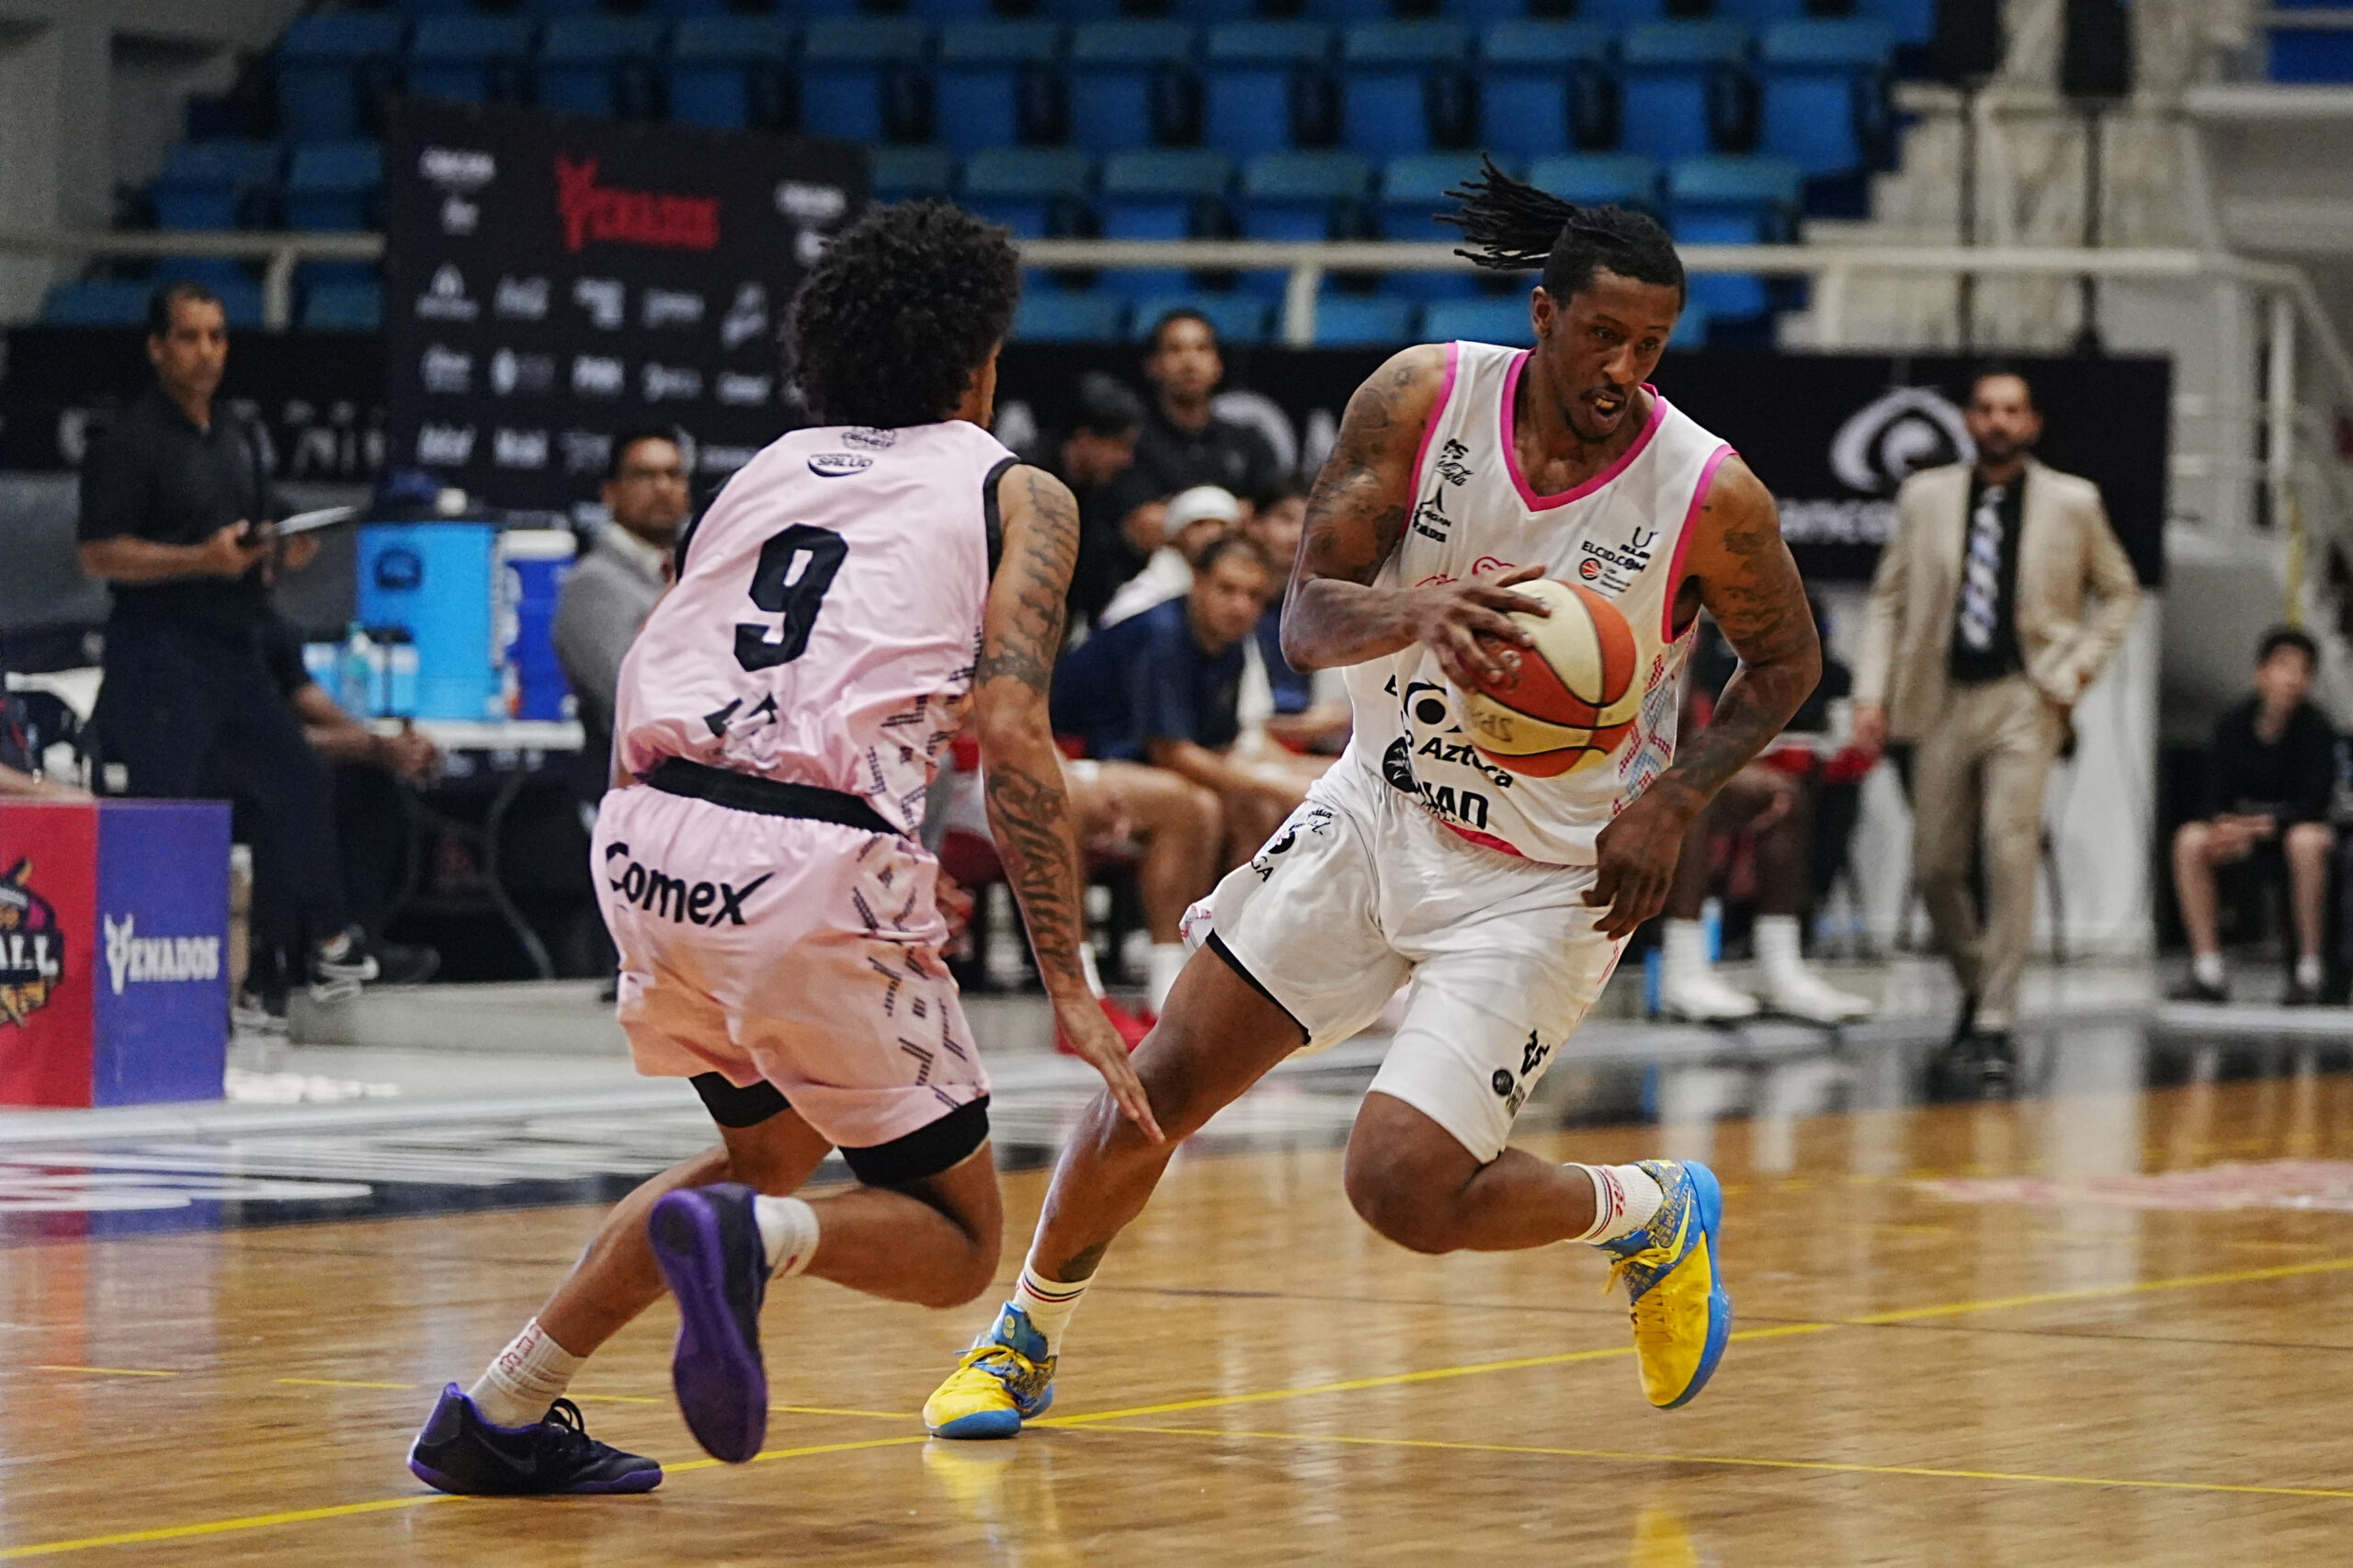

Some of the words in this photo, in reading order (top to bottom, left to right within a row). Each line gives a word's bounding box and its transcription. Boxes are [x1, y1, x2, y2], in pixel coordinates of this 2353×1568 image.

[733, 523, 849, 673] 9
[605, 841, 777, 927] Comex
[103, 913, 221, 995] VENADOS
